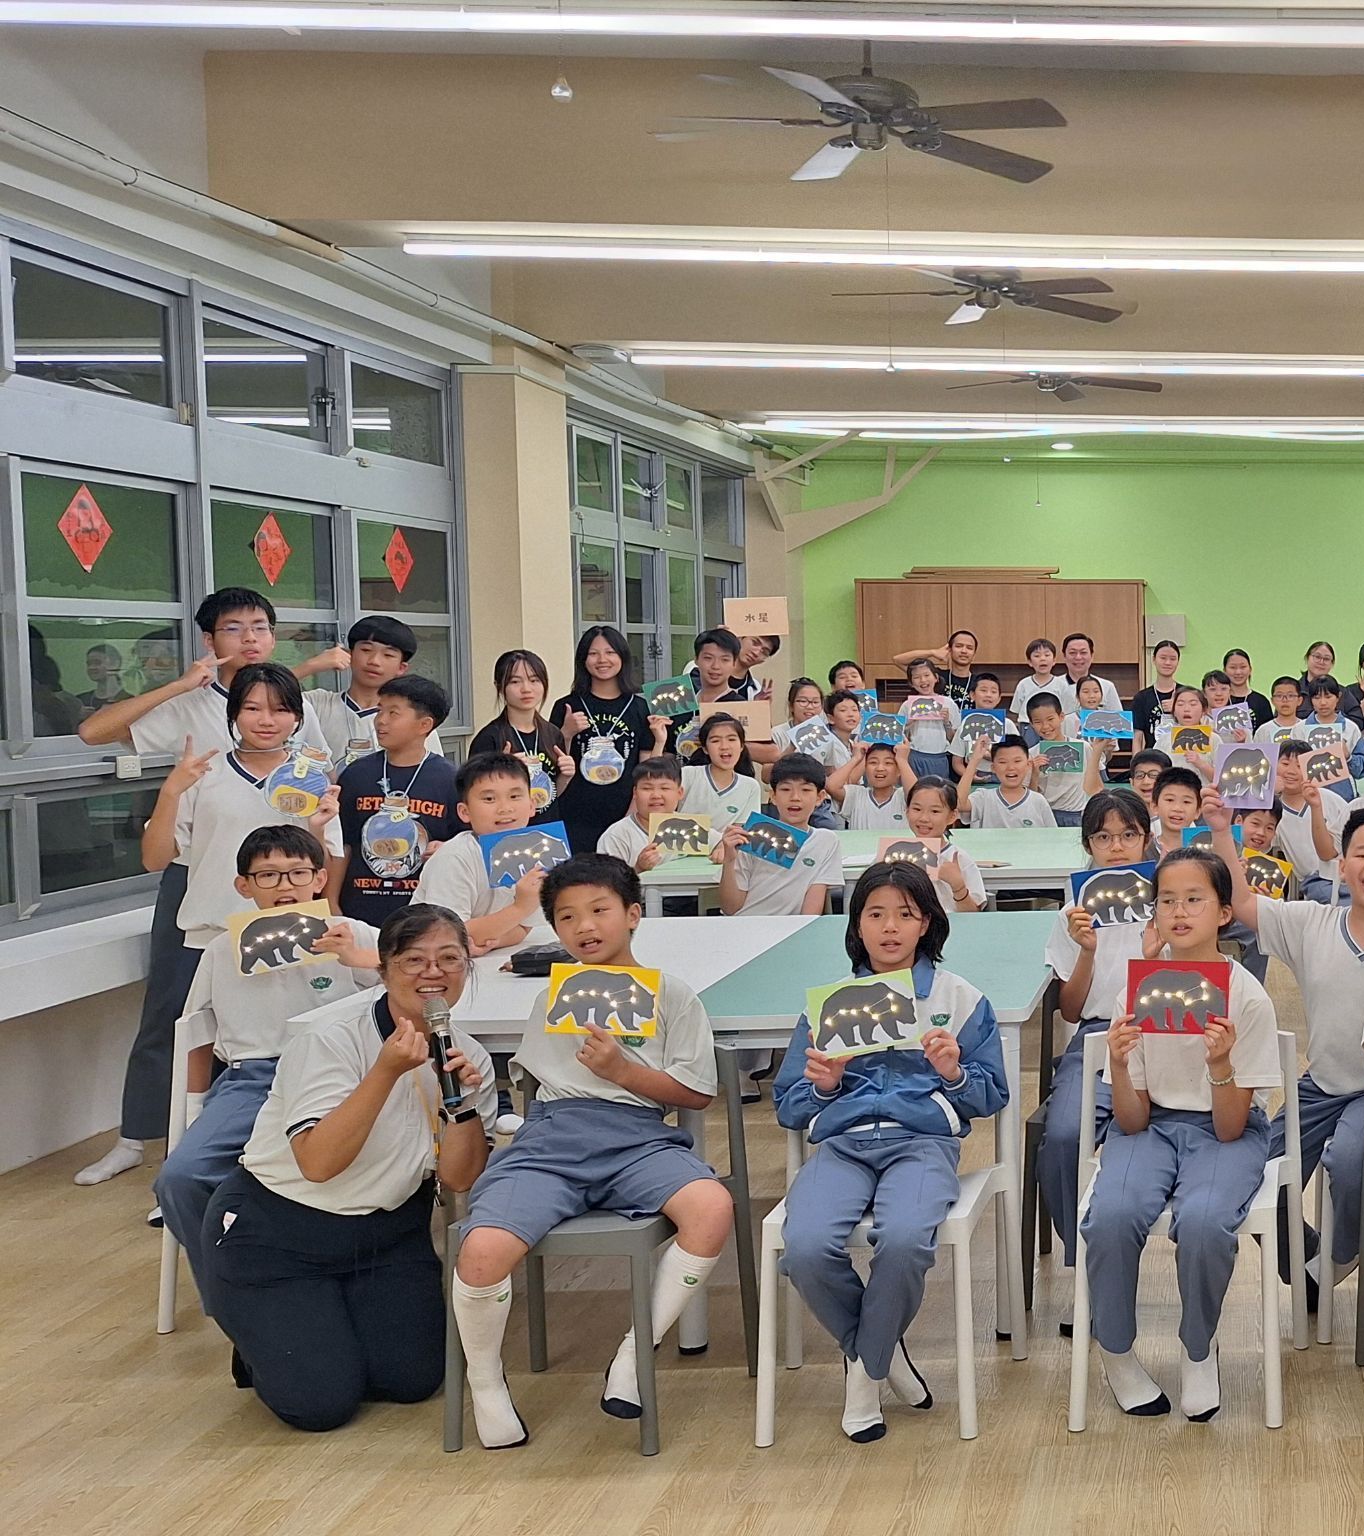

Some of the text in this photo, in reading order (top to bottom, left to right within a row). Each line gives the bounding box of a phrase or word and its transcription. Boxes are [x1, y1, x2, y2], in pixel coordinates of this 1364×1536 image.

[744, 612, 769, 623] 水星
[603, 714, 630, 732] LIGHT
[357, 797, 382, 810] GET
[354, 879, 382, 888] NEW
